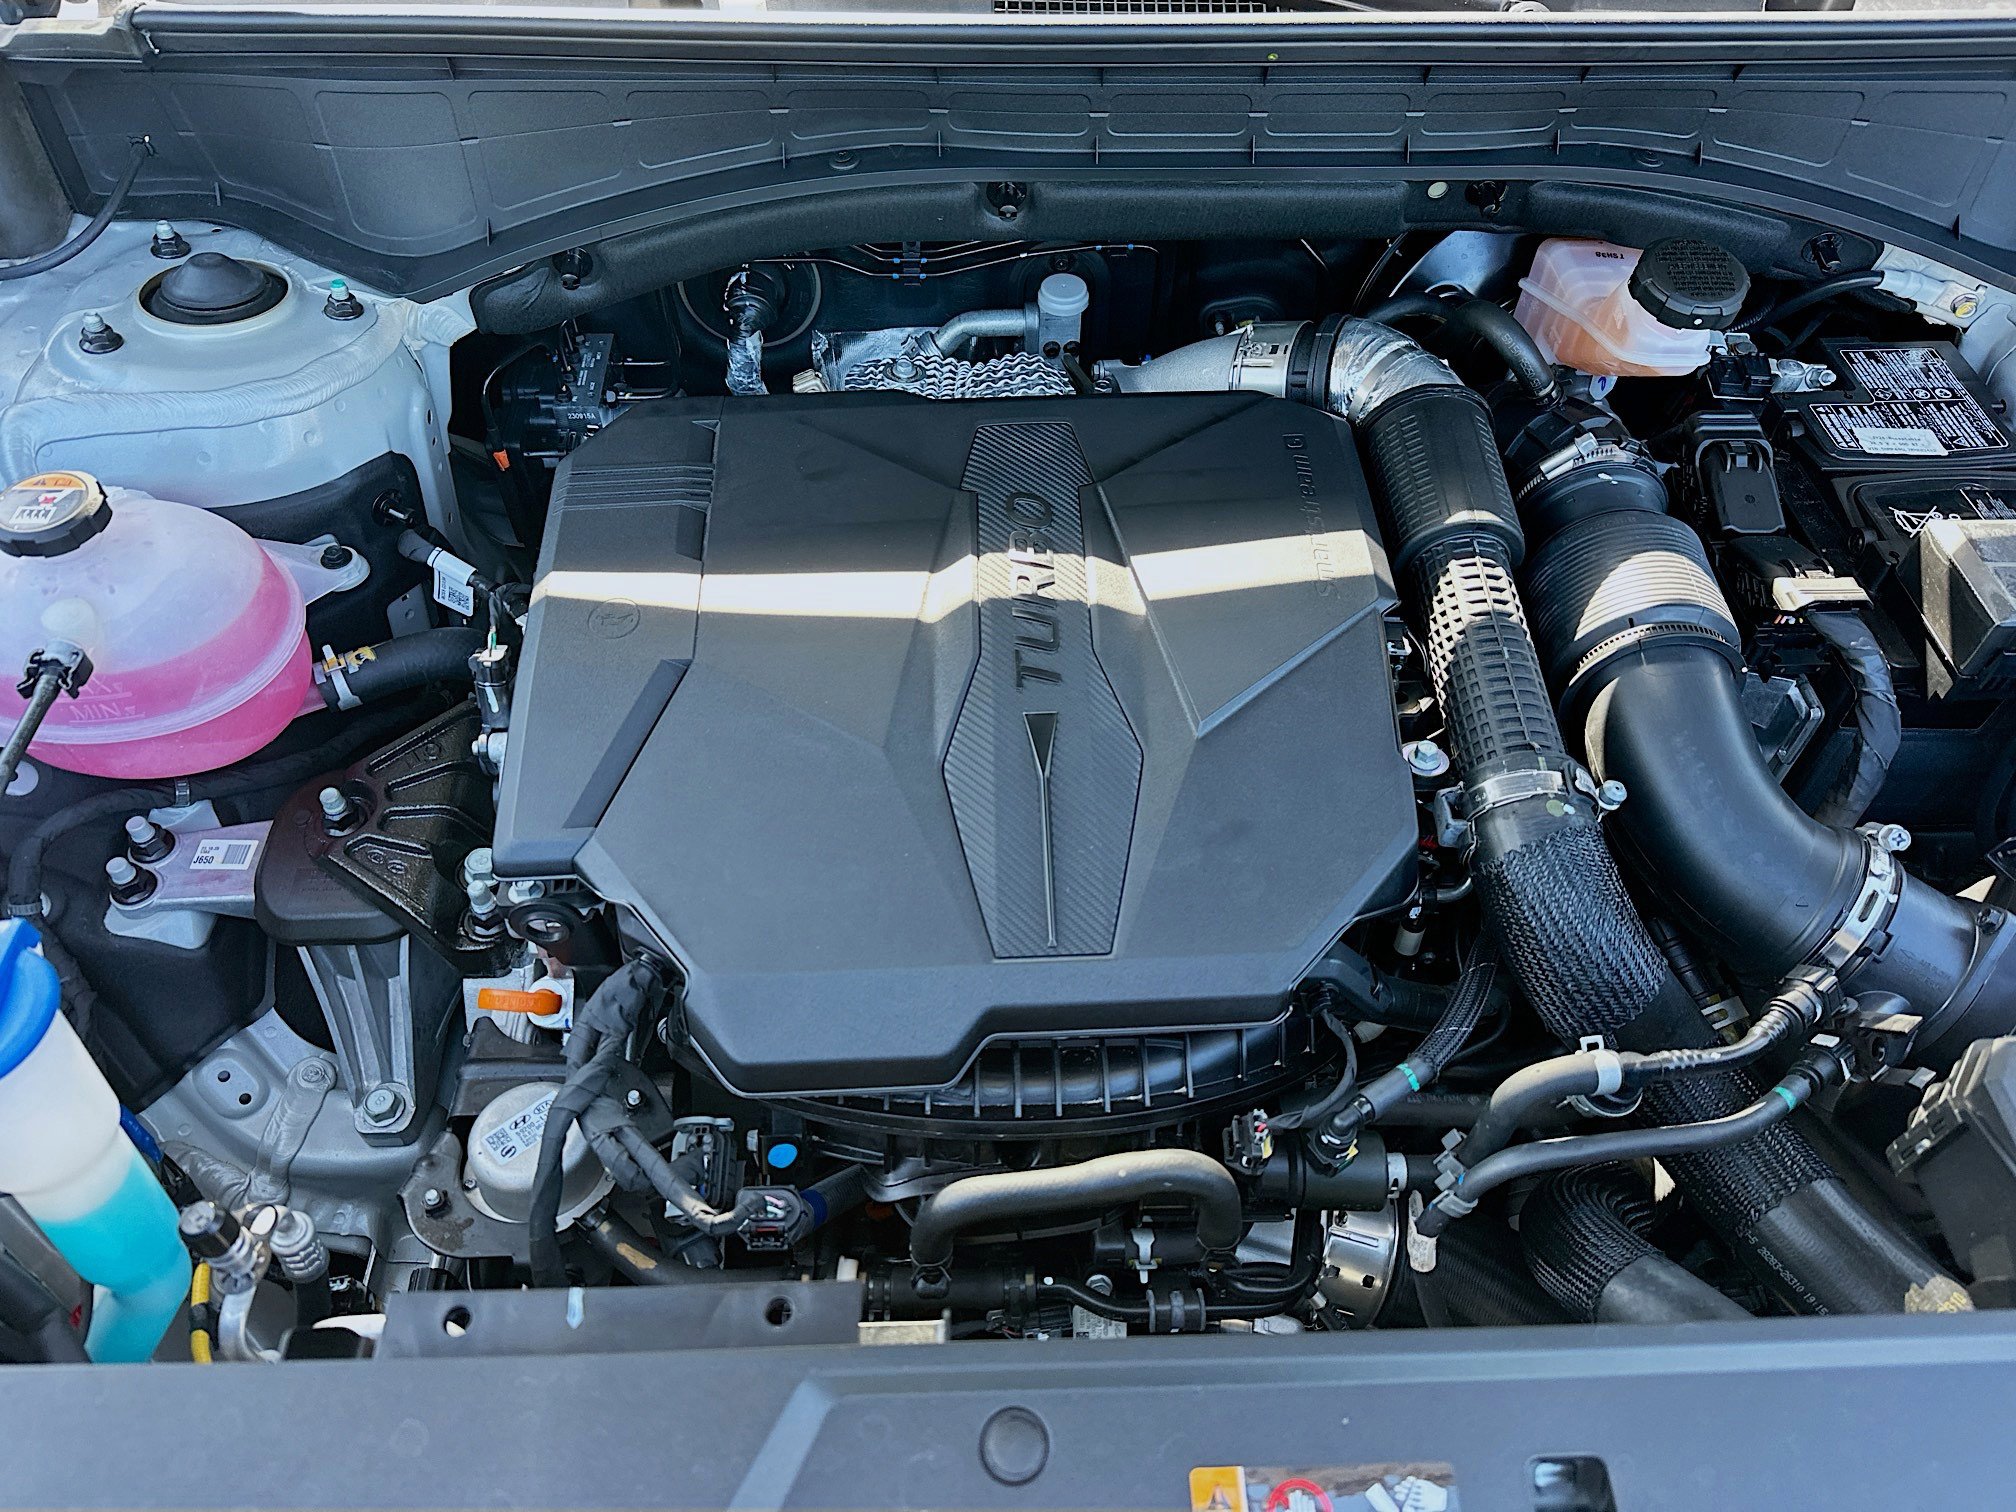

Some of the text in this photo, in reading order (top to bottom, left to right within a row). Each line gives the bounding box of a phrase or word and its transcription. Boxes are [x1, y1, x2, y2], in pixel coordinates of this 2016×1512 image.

[1006, 491, 1063, 693] TURBO
[69, 702, 122, 720] MIN
[193, 855, 214, 864] J650
[1757, 1246, 1805, 1292] 28283-2S310
